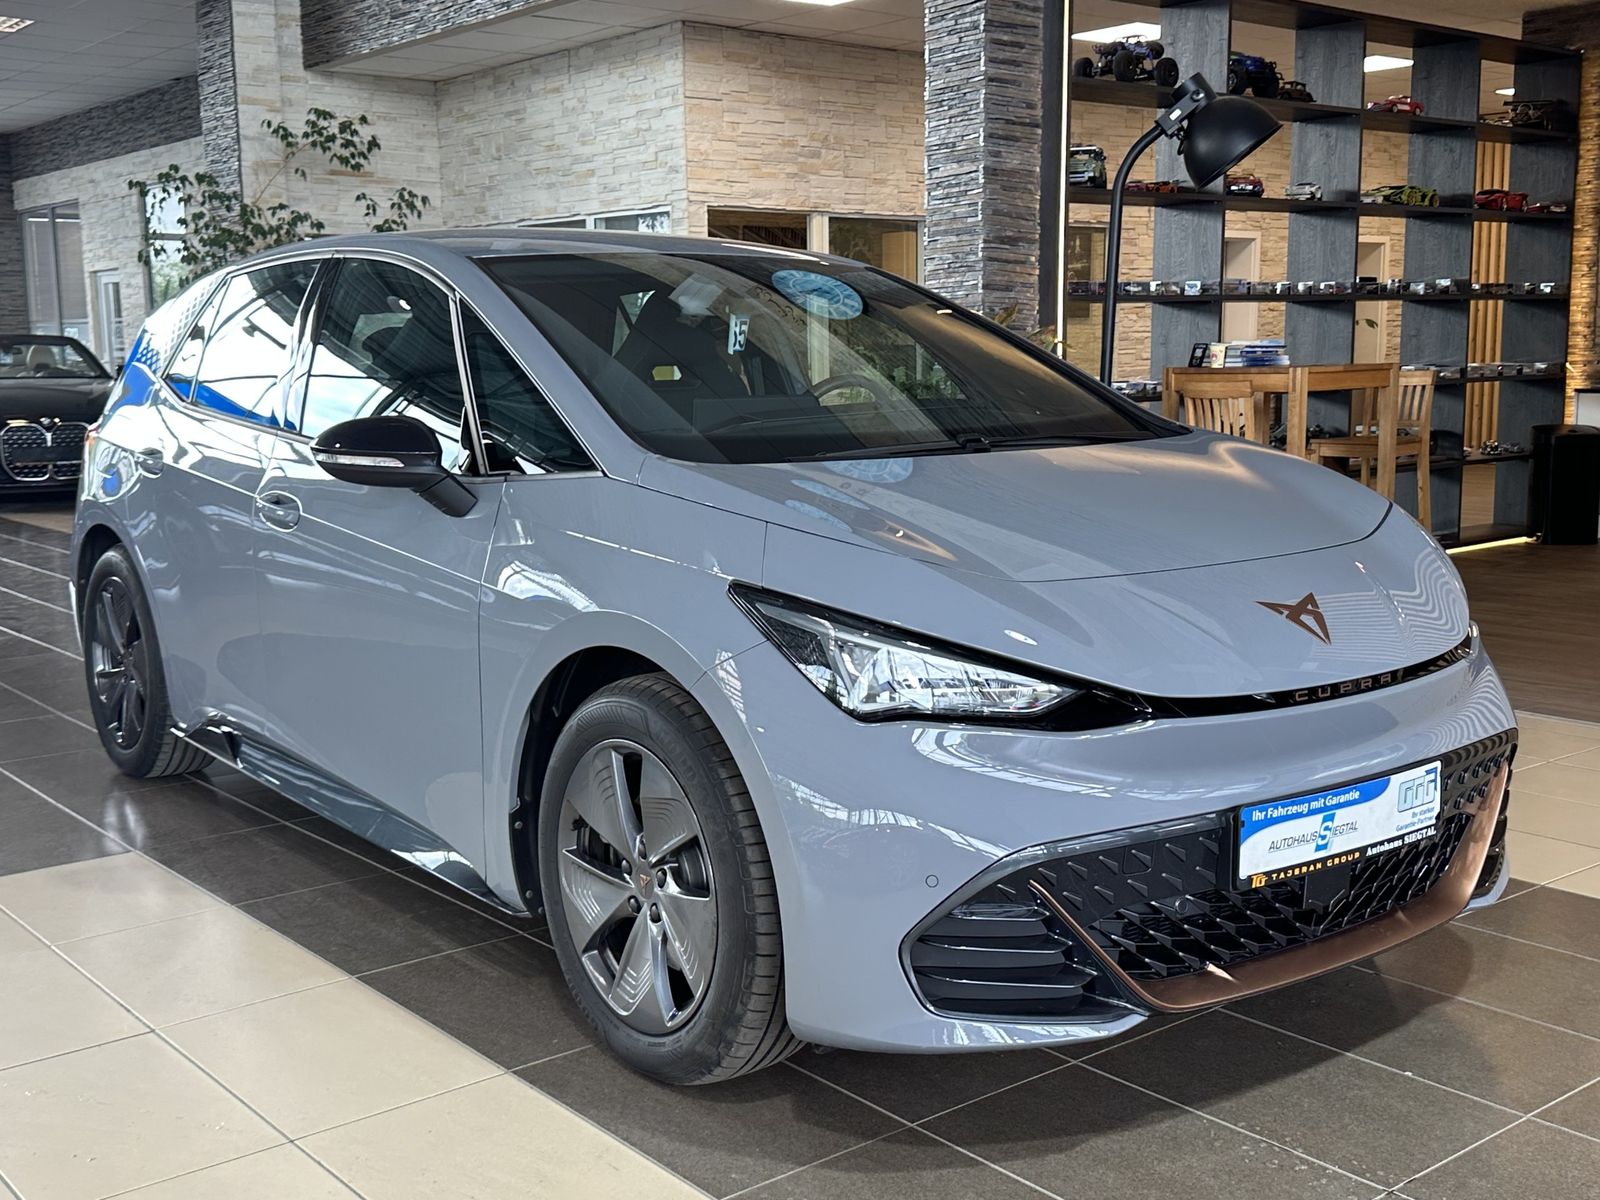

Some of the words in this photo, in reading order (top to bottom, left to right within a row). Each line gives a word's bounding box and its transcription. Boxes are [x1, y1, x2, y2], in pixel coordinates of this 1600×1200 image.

[1295, 672, 1392, 702] CUPRA
[1252, 810, 1266, 822] Ihr
[1267, 803, 1308, 819] Fahrzeug
[1310, 797, 1324, 810] mit
[1325, 788, 1360, 806] Garantie
[1268, 830, 1318, 852] AUTOHAUS
[1317, 820, 1359, 847] SIEGTAL
[1366, 838, 1403, 857] Autohaus
[1403, 826, 1437, 844] SIEGTAL
[1271, 862, 1322, 881] TAJERAN
[1326, 851, 1361, 867] GROUP
